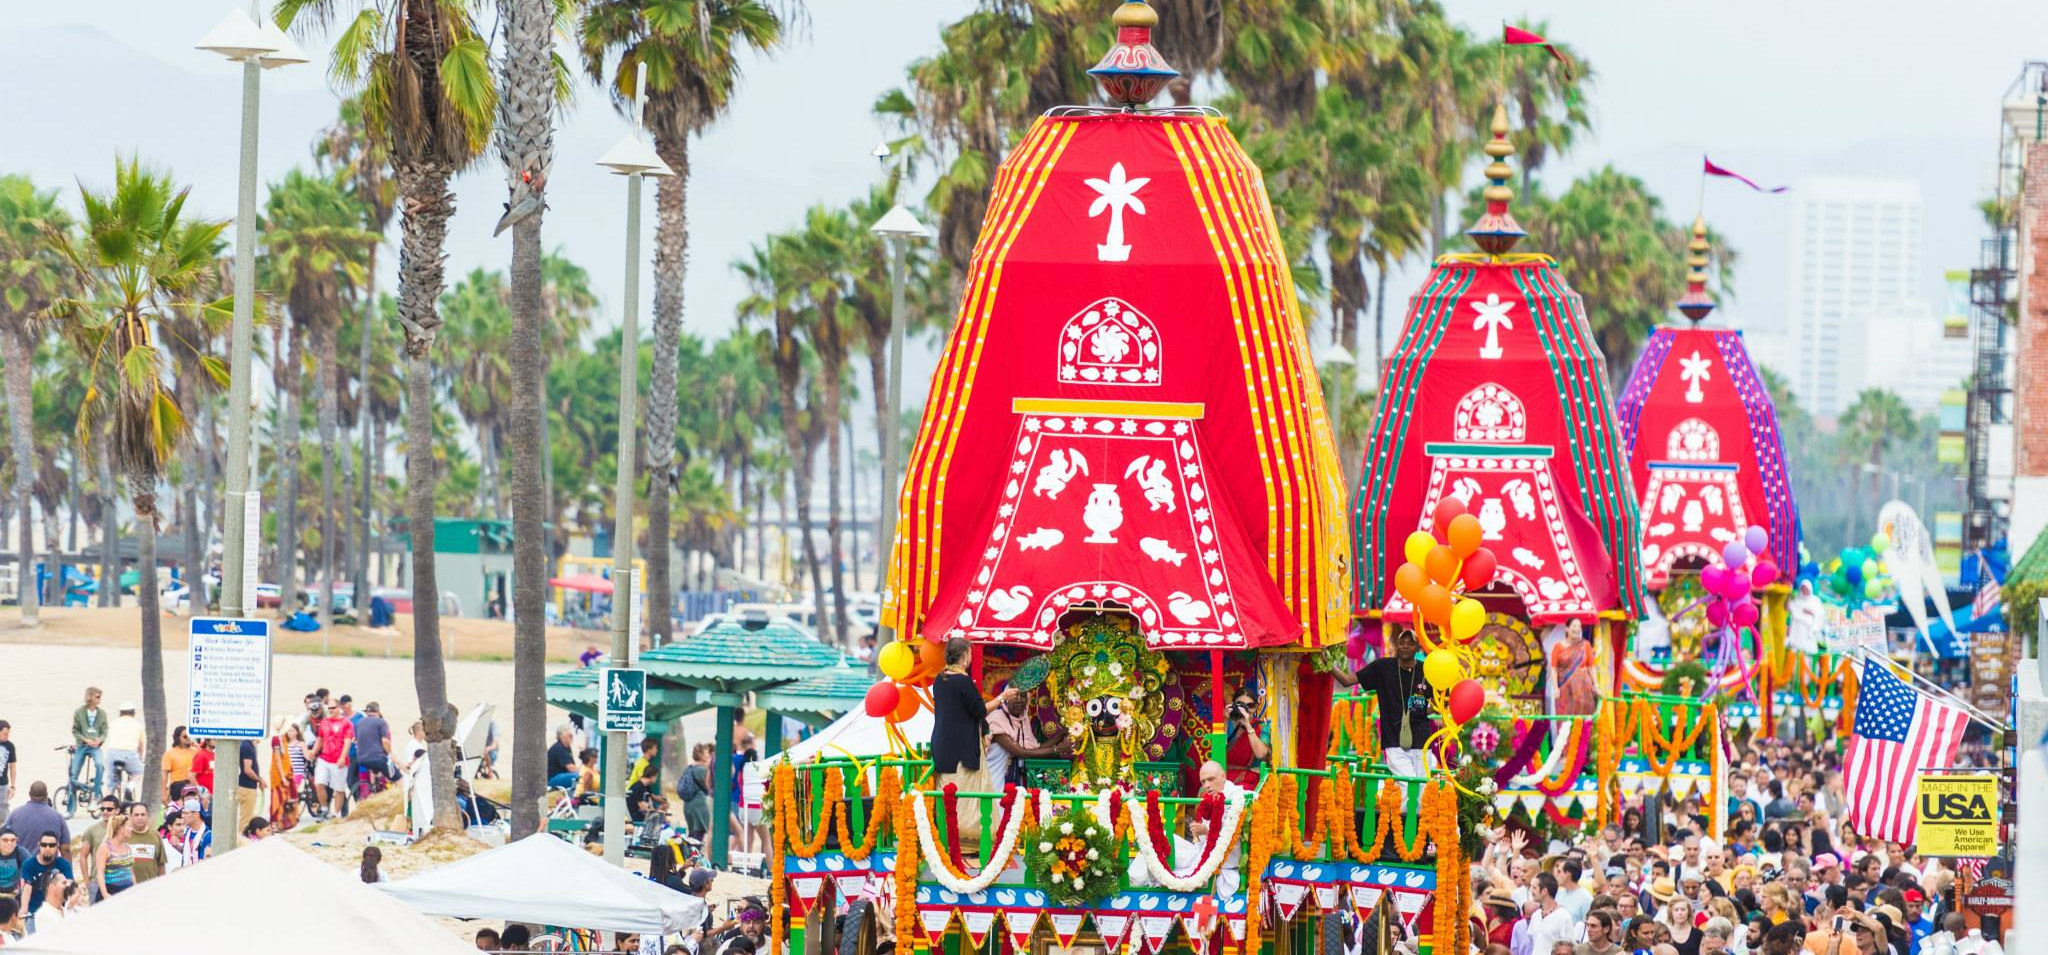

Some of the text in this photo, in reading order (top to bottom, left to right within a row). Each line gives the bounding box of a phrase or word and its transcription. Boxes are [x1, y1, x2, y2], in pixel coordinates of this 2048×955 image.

[1922, 784, 1992, 793] MADE IN THE
[1922, 793, 1992, 820] USA
